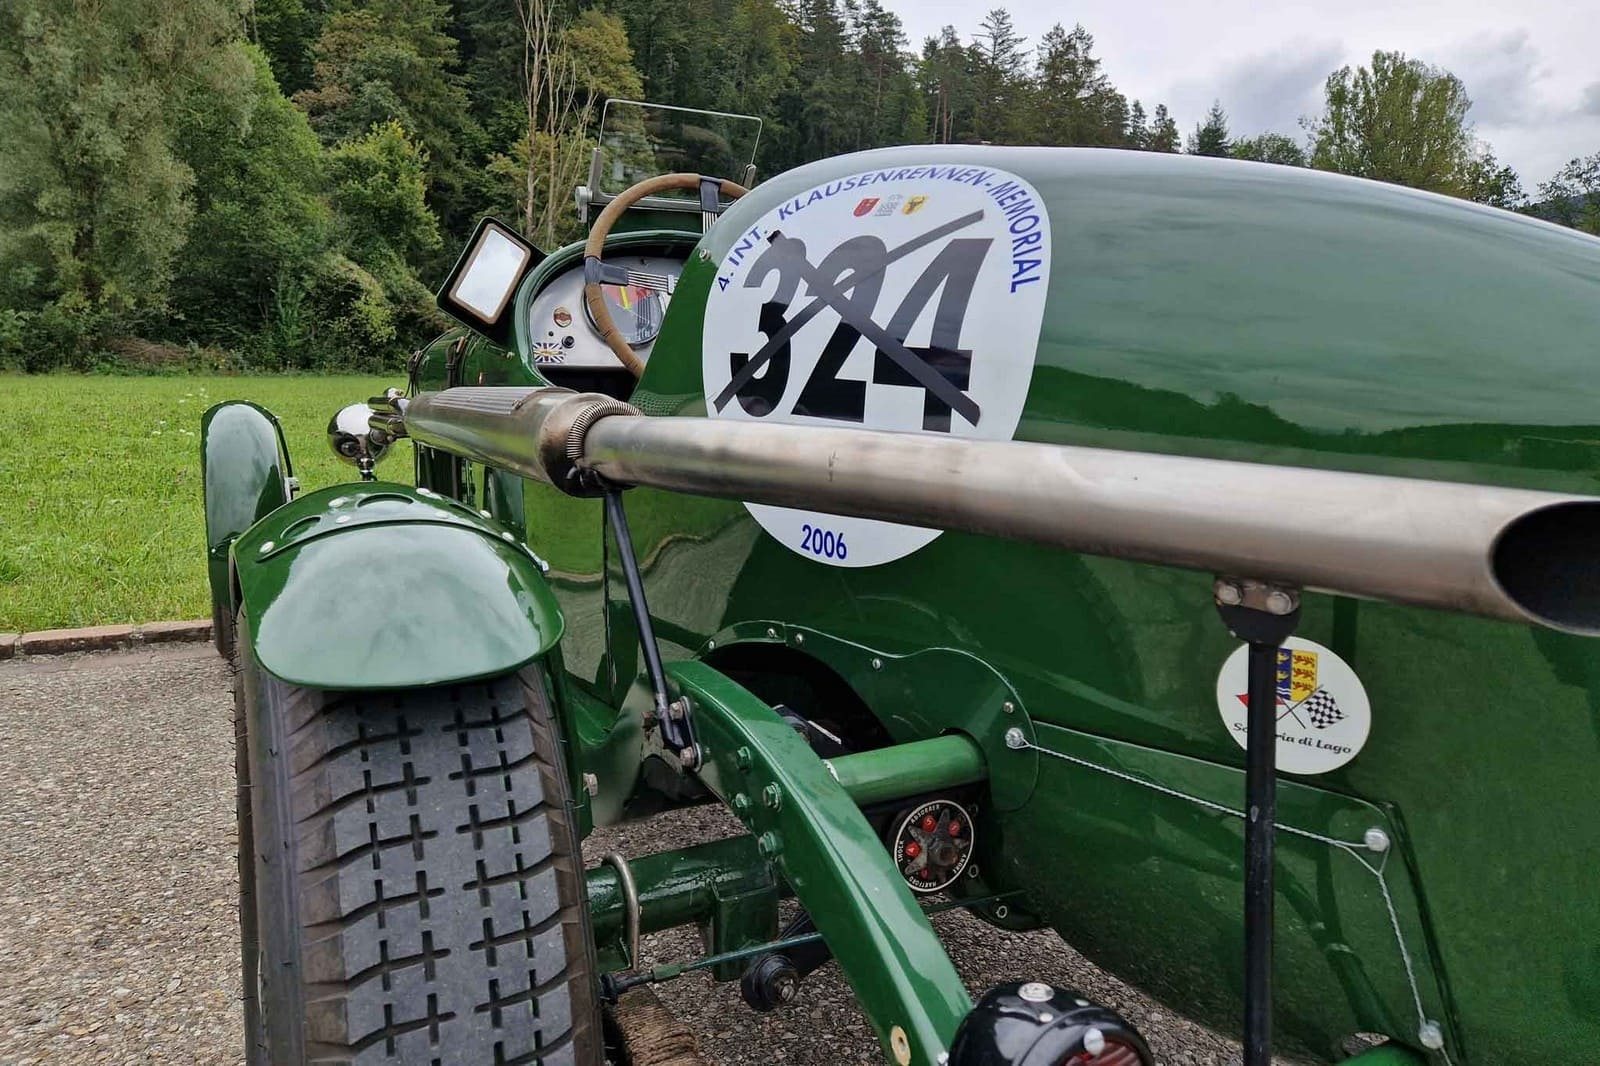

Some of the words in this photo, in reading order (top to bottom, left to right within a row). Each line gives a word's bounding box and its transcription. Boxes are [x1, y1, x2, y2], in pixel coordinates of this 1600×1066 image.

[717, 272, 735, 292] 4.
[728, 228, 769, 267] INT.
[729, 234, 995, 433] 324
[801, 524, 847, 560] 2006
[1299, 737, 1313, 747] di
[1316, 740, 1352, 755] Lago
